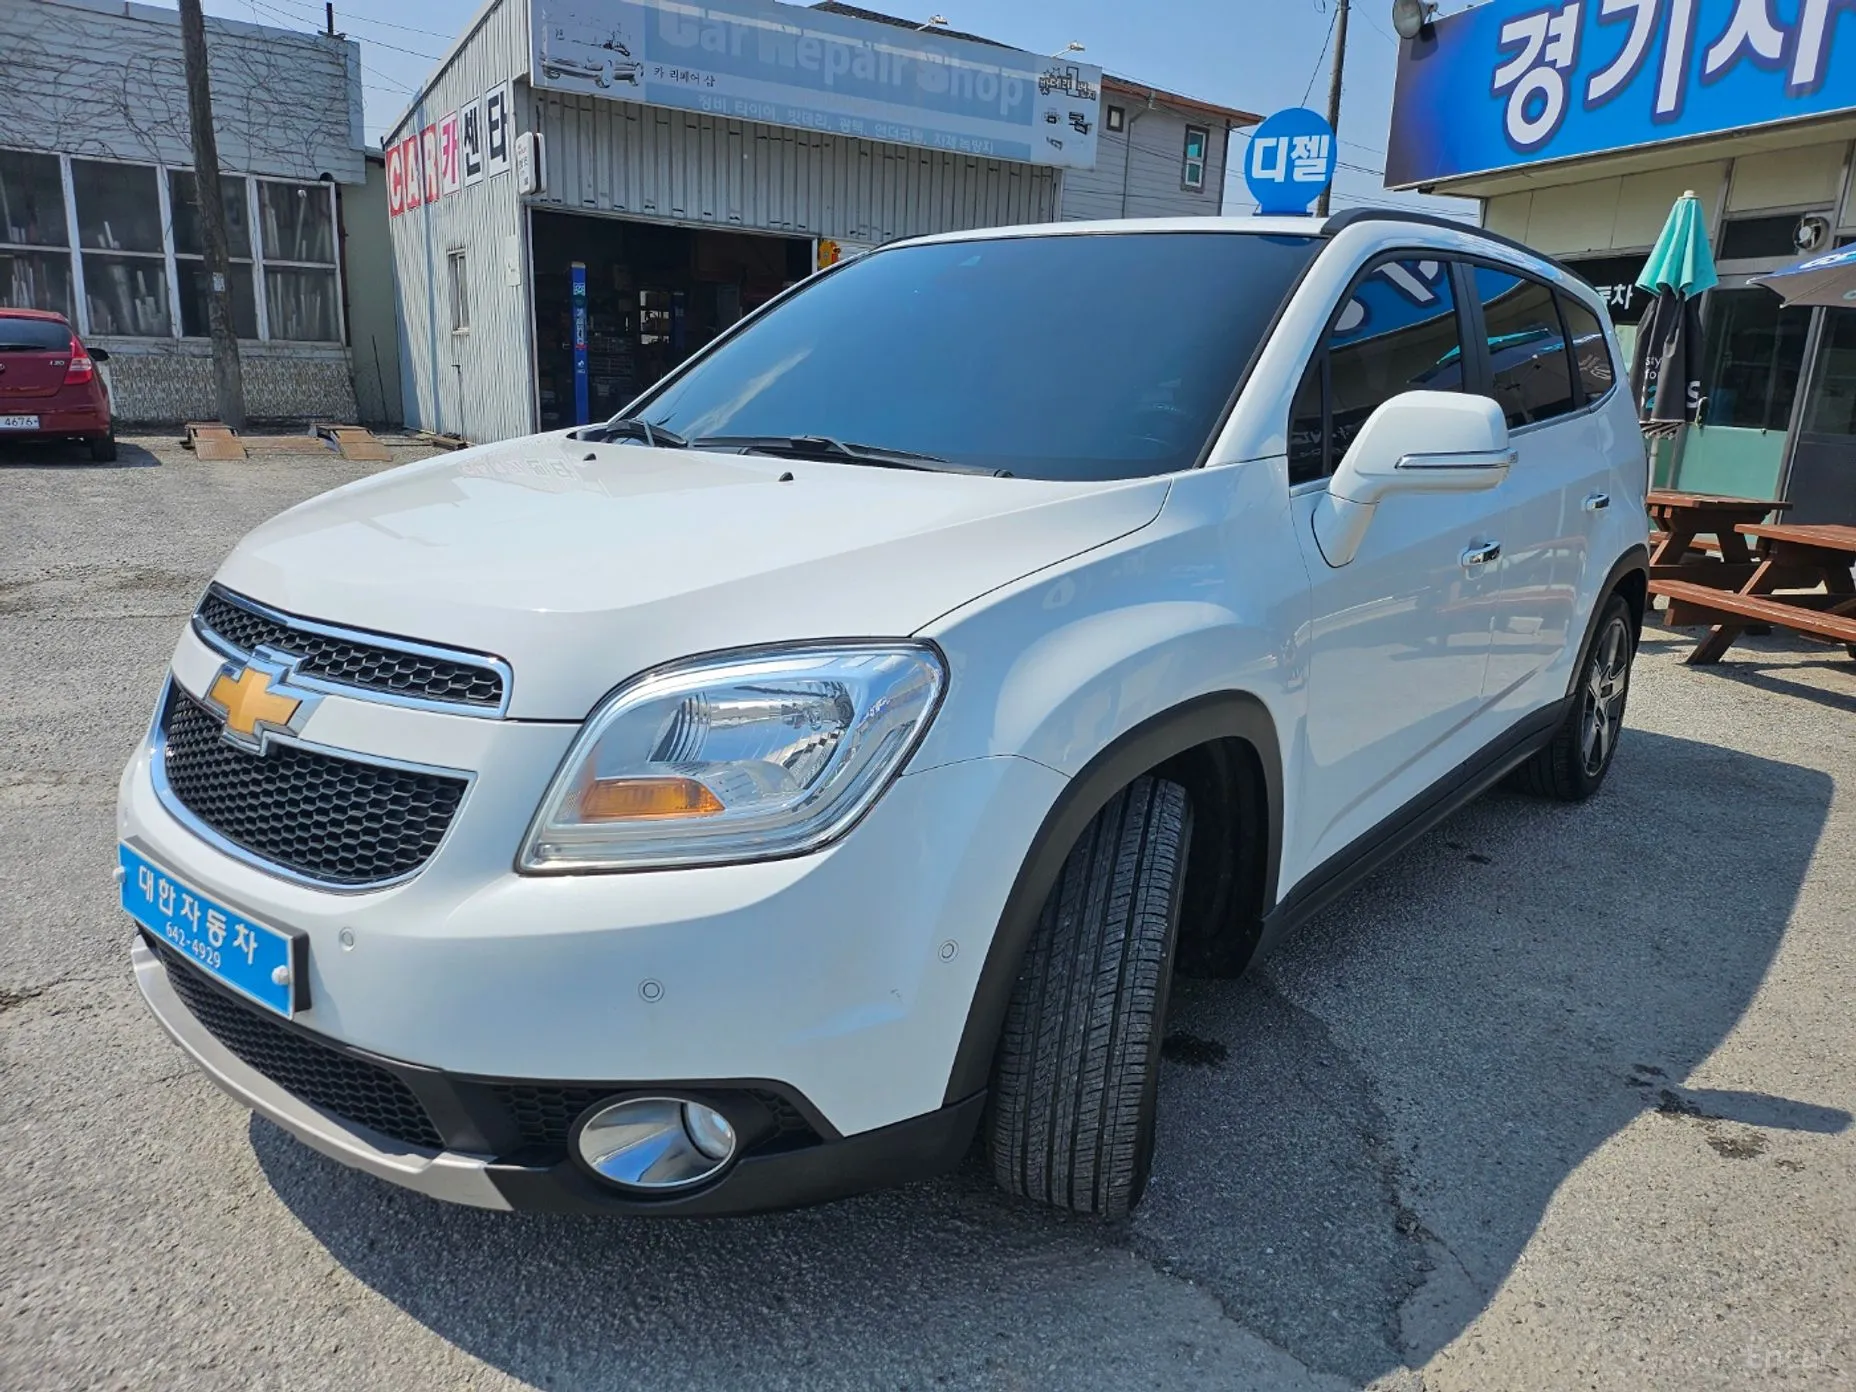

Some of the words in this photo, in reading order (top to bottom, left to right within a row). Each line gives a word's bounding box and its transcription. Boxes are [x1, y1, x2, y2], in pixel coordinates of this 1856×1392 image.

[758, 12, 909, 86] Repair
[915, 43, 1024, 116] Shop
[1252, 134, 1330, 183] 디젤
[4, 416, 34, 427] 4676
[166, 921, 222, 969] 642-4929
